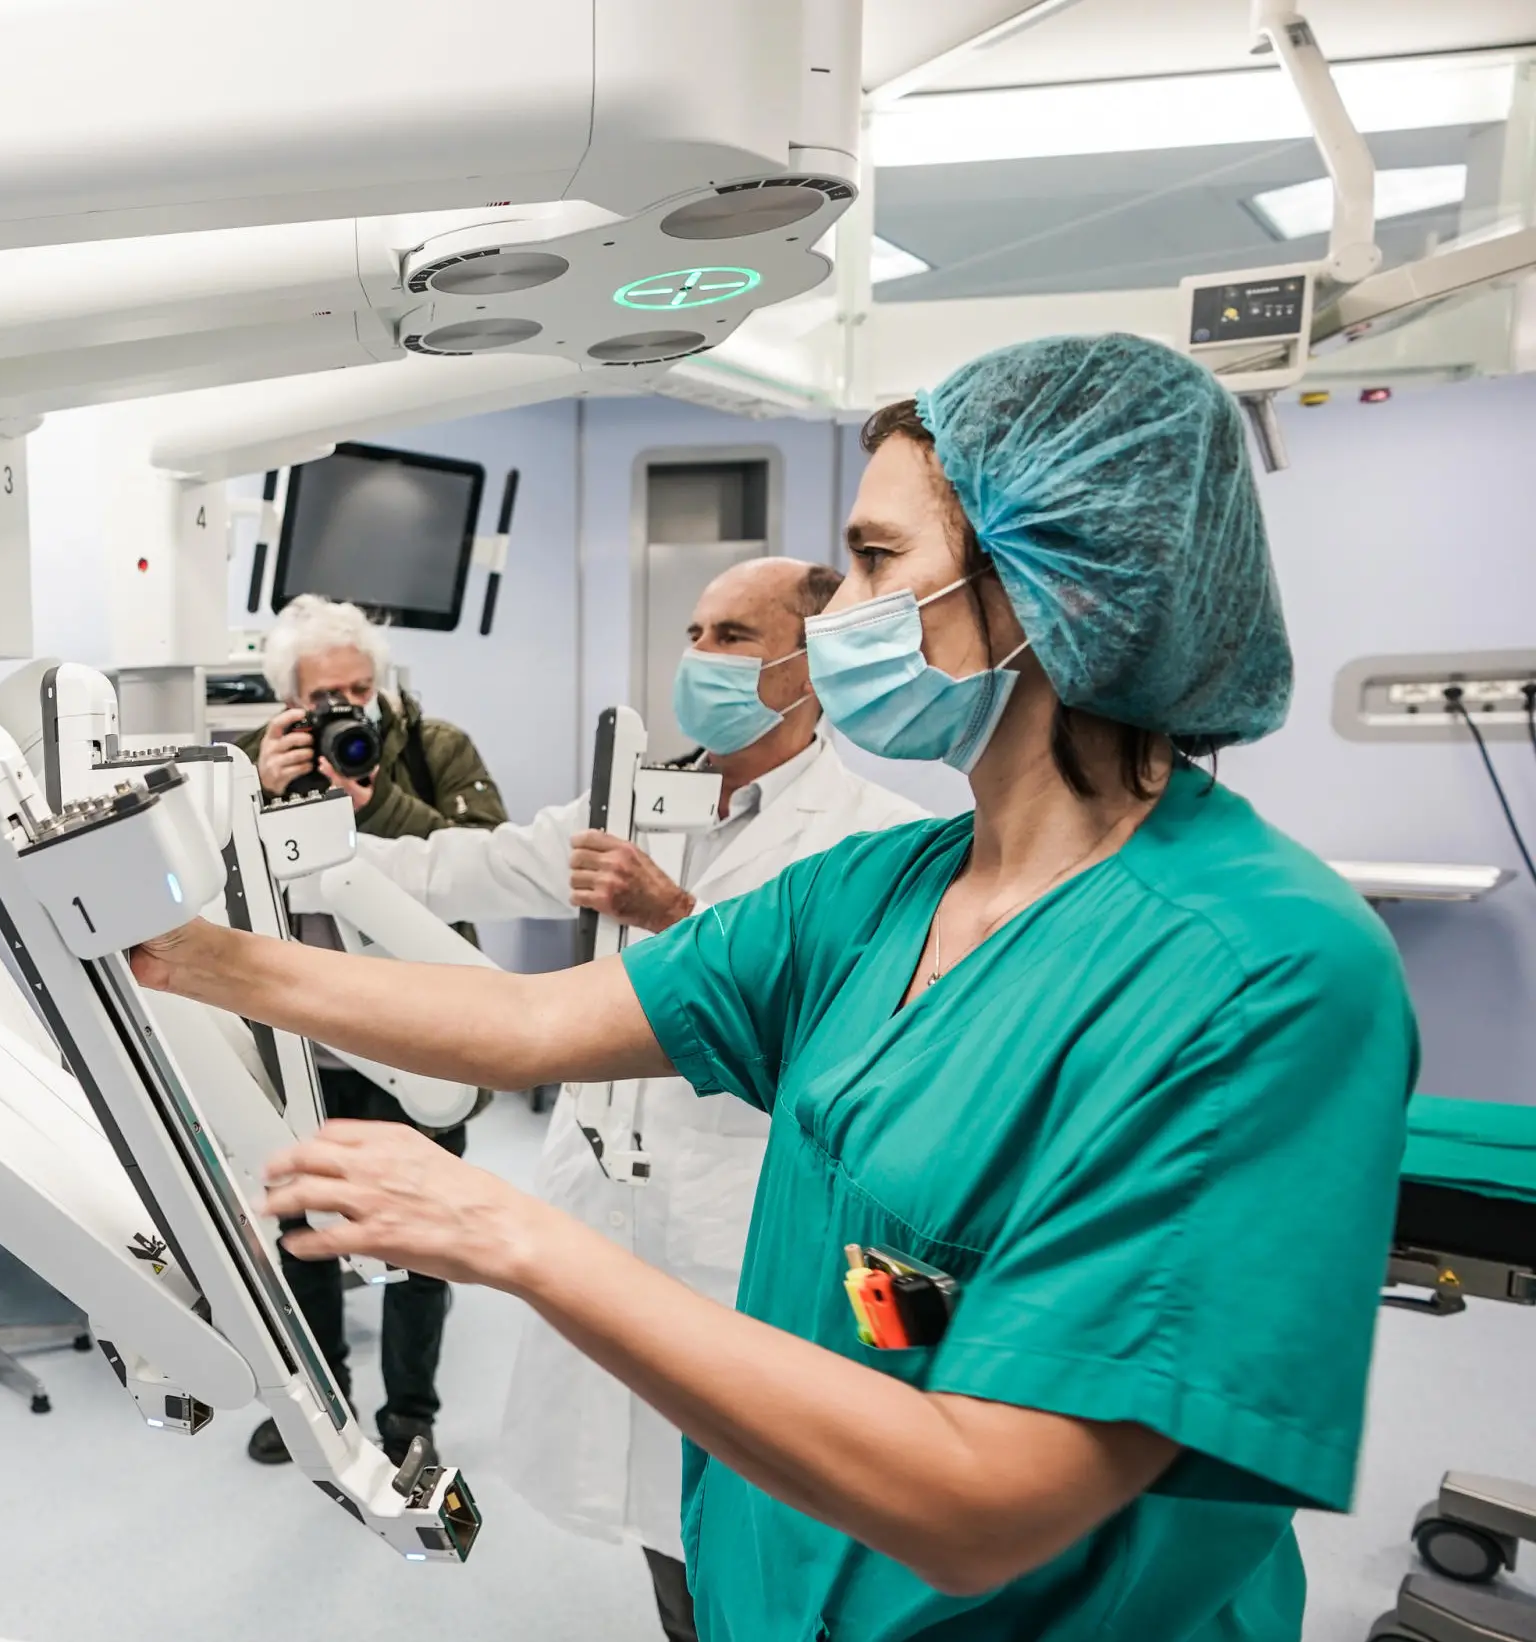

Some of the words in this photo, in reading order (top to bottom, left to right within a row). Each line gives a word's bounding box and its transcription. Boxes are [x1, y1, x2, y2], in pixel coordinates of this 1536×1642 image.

[4, 465, 13, 494] 3
[196, 505, 206, 529] 4
[652, 796, 665, 814] 4
[285, 839, 300, 861] 3
[72, 896, 96, 933] 1
